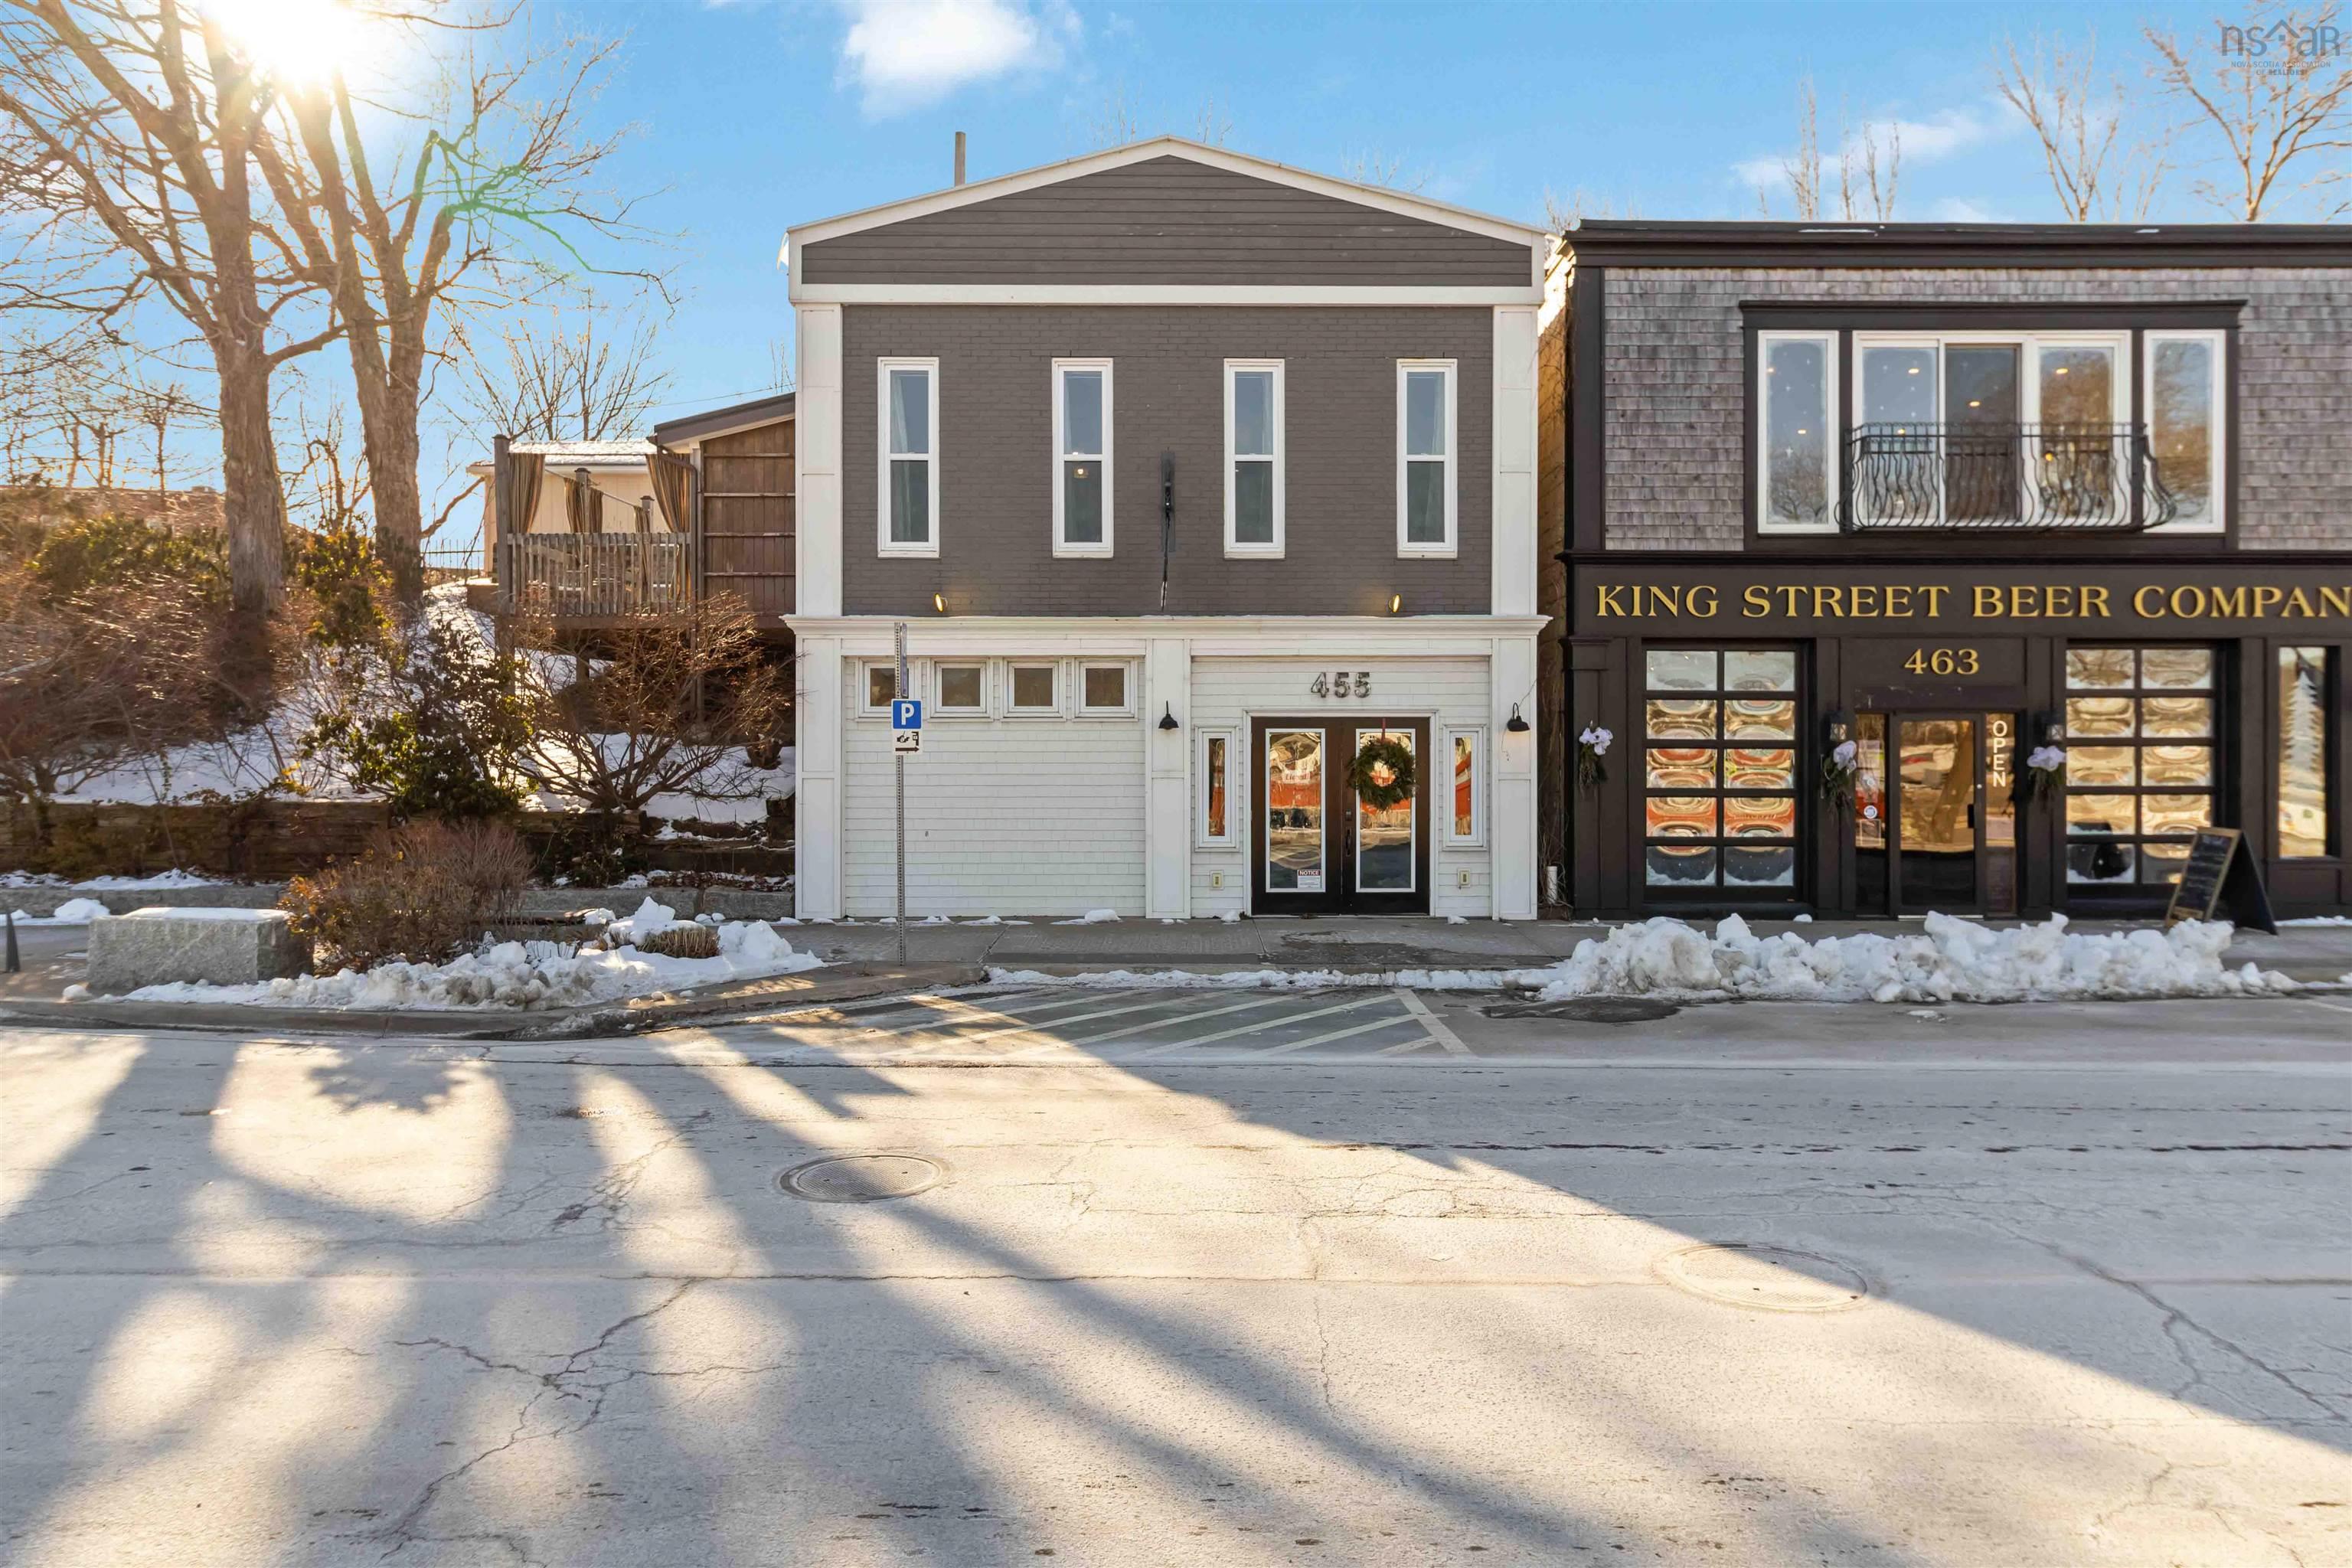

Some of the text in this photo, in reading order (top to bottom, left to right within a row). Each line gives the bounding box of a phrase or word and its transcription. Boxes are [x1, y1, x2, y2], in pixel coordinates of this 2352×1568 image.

[1597, 586, 2352, 618] KING STREET BEER COMPAN
[1905, 649, 1979, 675] 463
[1311, 671, 1371, 698] 455
[901, 703, 915, 725] P
[1992, 720, 2007, 788] OPEN
